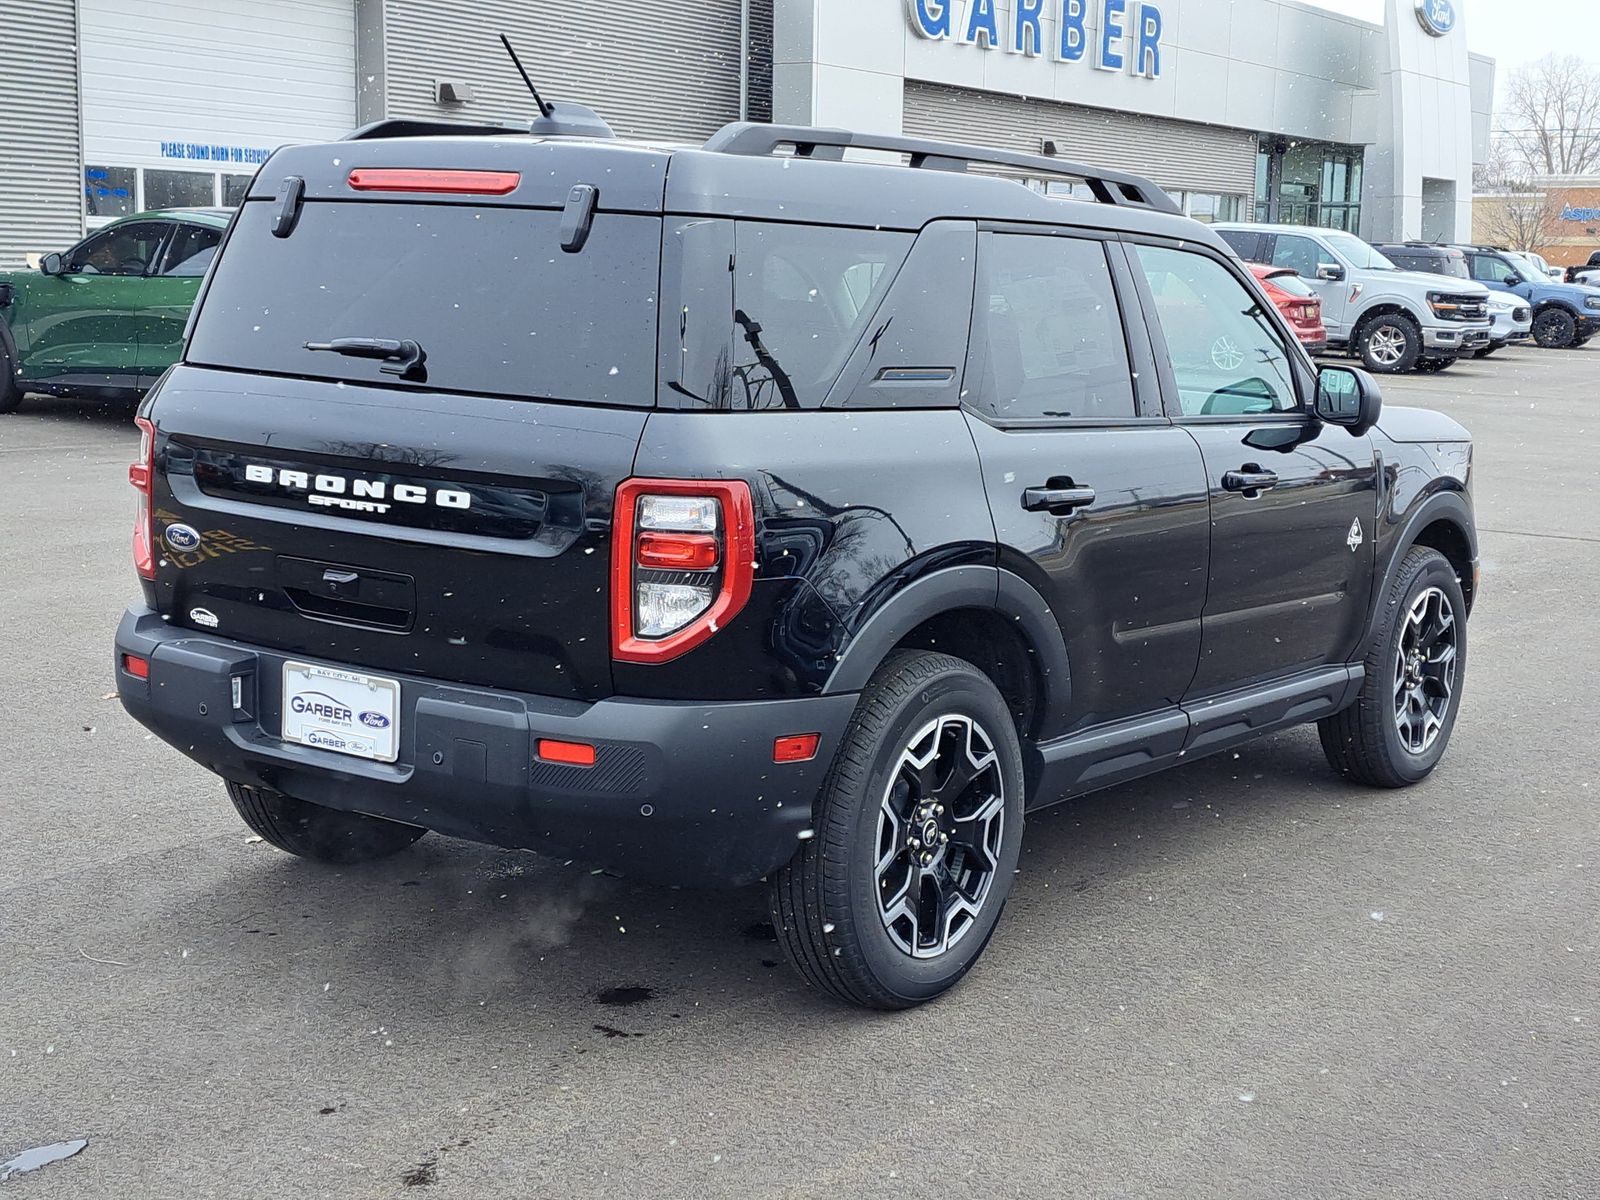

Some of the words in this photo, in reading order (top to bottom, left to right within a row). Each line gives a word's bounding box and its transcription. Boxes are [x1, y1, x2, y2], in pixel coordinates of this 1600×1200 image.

[908, 0, 1162, 79] GARBER
[161, 142, 185, 158] PLEASE
[186, 143, 210, 160] SOUND
[211, 145, 229, 161] HORN
[230, 147, 243, 162] FOR
[245, 464, 471, 509] BRONCO
[308, 494, 391, 513] SPORT
[171, 528, 190, 544] Ford
[291, 696, 352, 722] GARBER
[364, 713, 384, 727] Ford
[308, 733, 346, 748] GARBER
